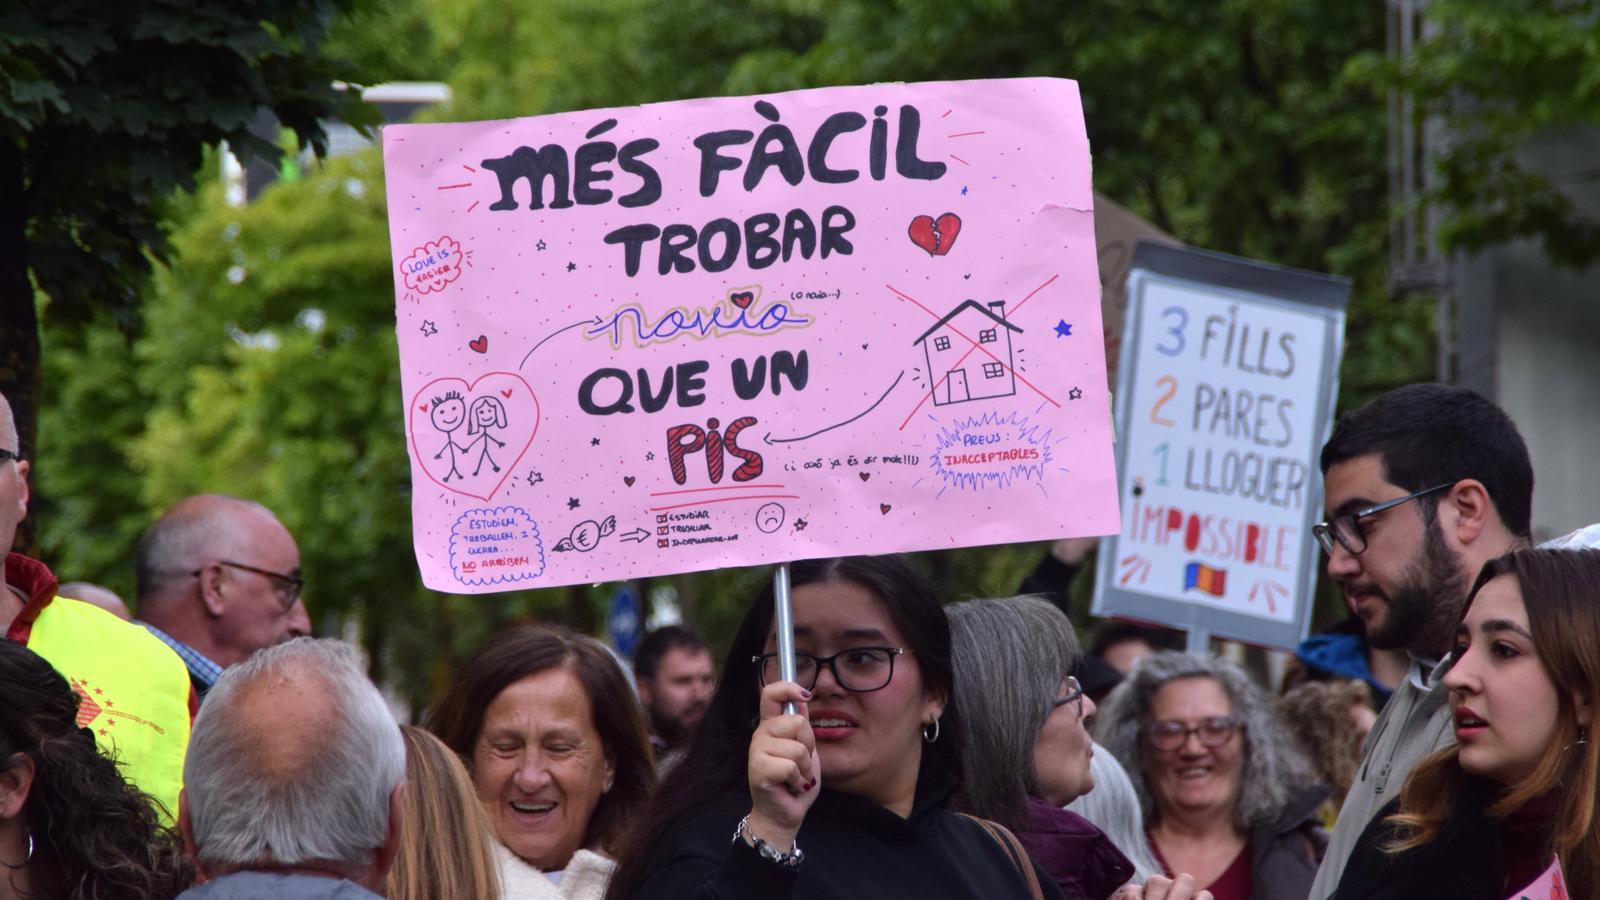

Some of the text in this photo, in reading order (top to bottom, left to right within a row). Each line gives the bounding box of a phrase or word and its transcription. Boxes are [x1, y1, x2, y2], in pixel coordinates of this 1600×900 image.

[480, 118, 662, 211] MÉS
[408, 256, 436, 273] LOVE
[603, 205, 856, 277] TROBAR
[588, 291, 808, 345] novio
[1155, 305, 1189, 357] 3
[577, 349, 809, 416] QUE UN
[1150, 374, 1295, 449] 2 PARES
[944, 448, 1040, 466] INACCEPTABLES
[1151, 441, 1309, 511] 1 LLOGUER
[462, 561, 477, 570] NO
